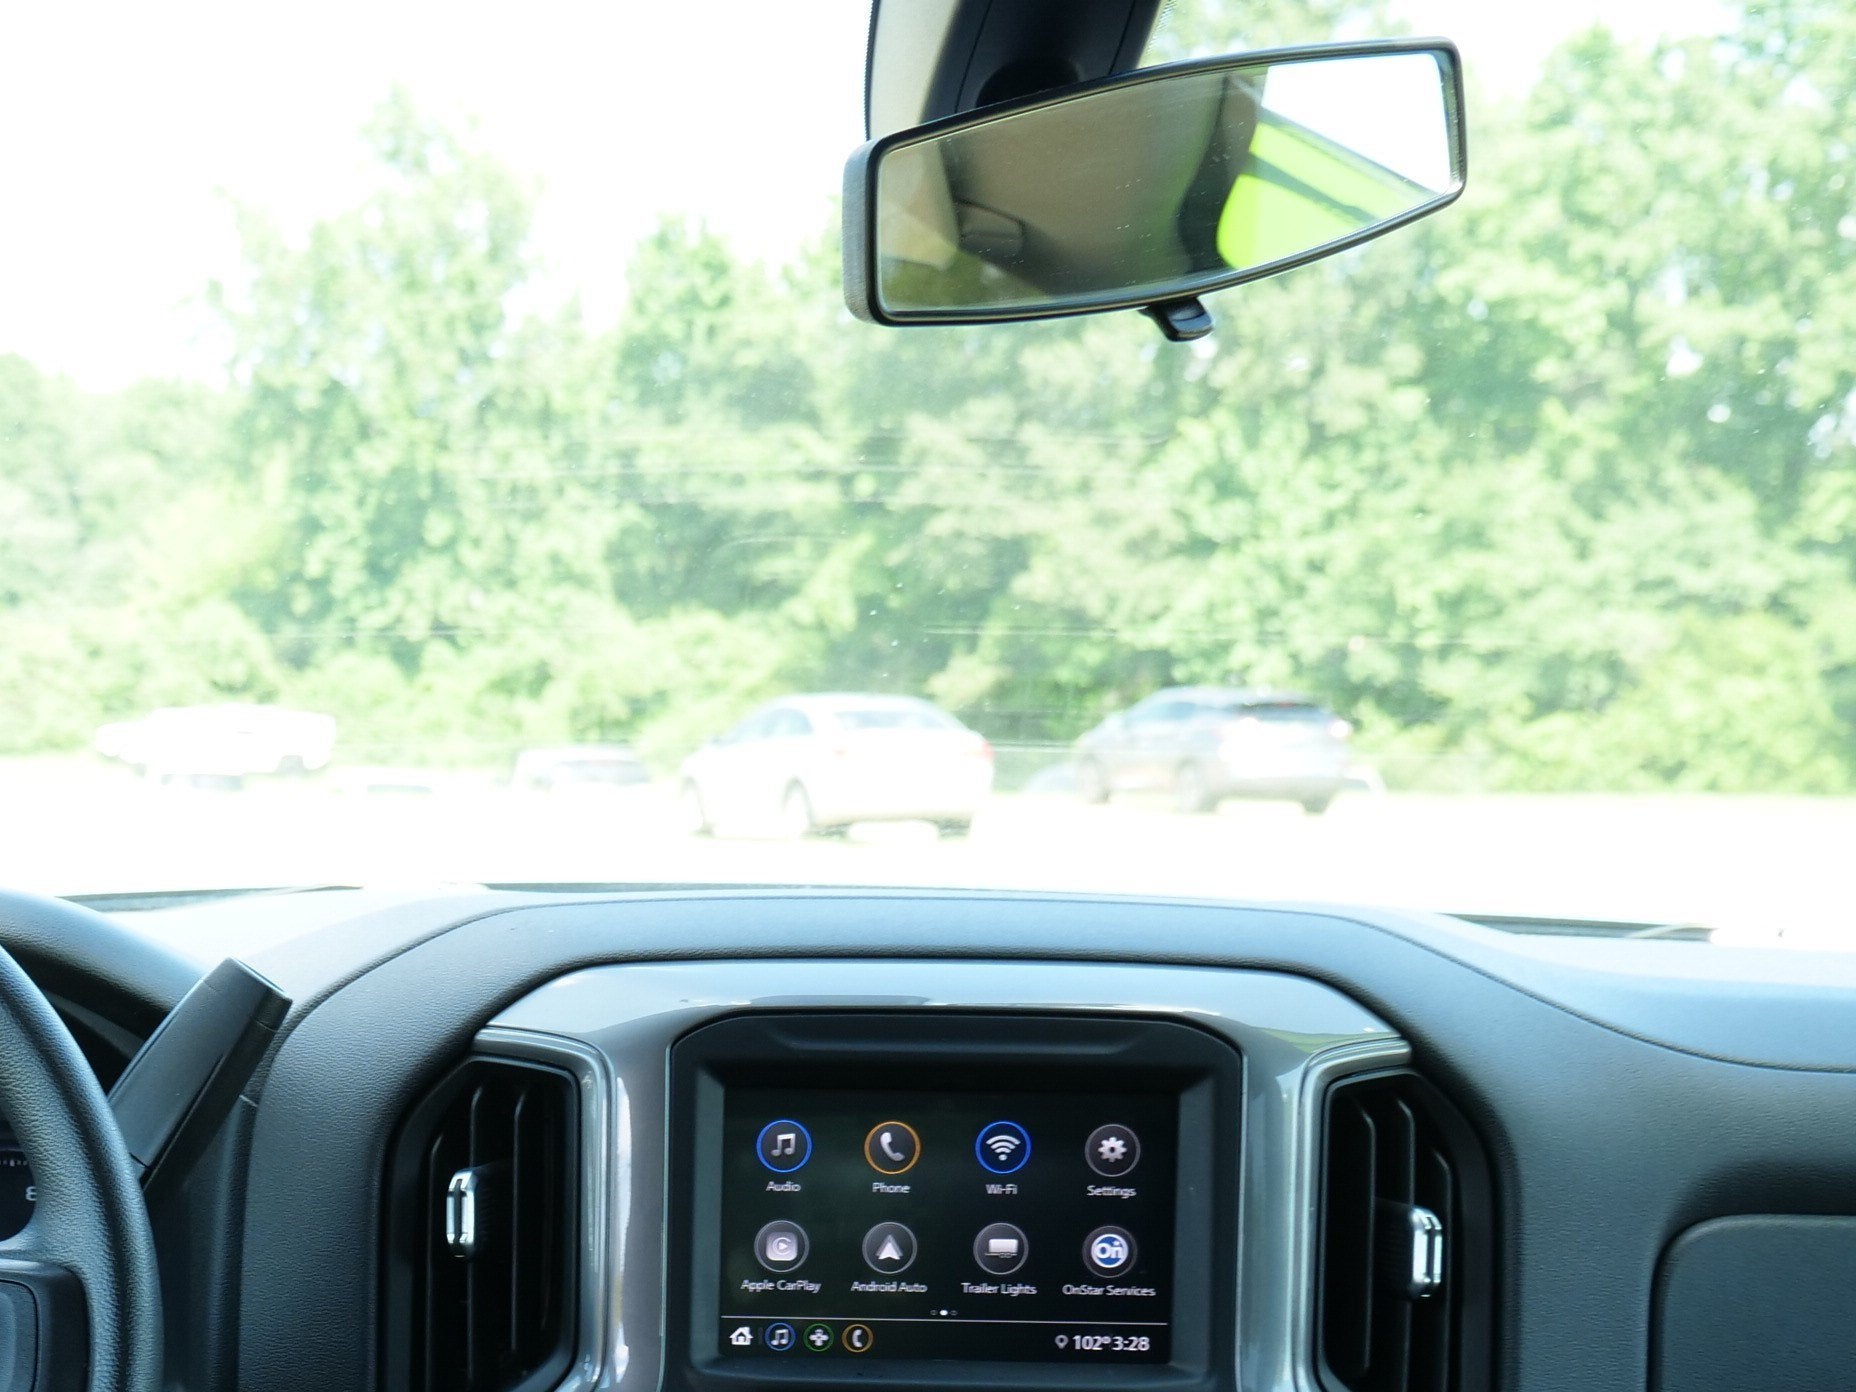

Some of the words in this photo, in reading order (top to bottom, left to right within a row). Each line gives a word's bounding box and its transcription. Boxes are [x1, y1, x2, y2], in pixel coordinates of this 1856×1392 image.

[765, 1181, 802, 1192] Audio
[871, 1182, 911, 1194] Phone
[985, 1184, 1018, 1195] Wi-Fi
[1086, 1185, 1137, 1199] Settings
[1095, 1240, 1124, 1259] On
[740, 1279, 775, 1293] Apple
[776, 1279, 822, 1293] CarPlay
[850, 1281, 897, 1293] Android
[898, 1282, 928, 1293] Auto
[961, 1282, 999, 1294] Trailer
[1001, 1283, 1037, 1296] Lights
[1062, 1284, 1105, 1295] OnStar
[1106, 1284, 1156, 1296] Services
[1111, 1336, 1150, 1351] 3:28
